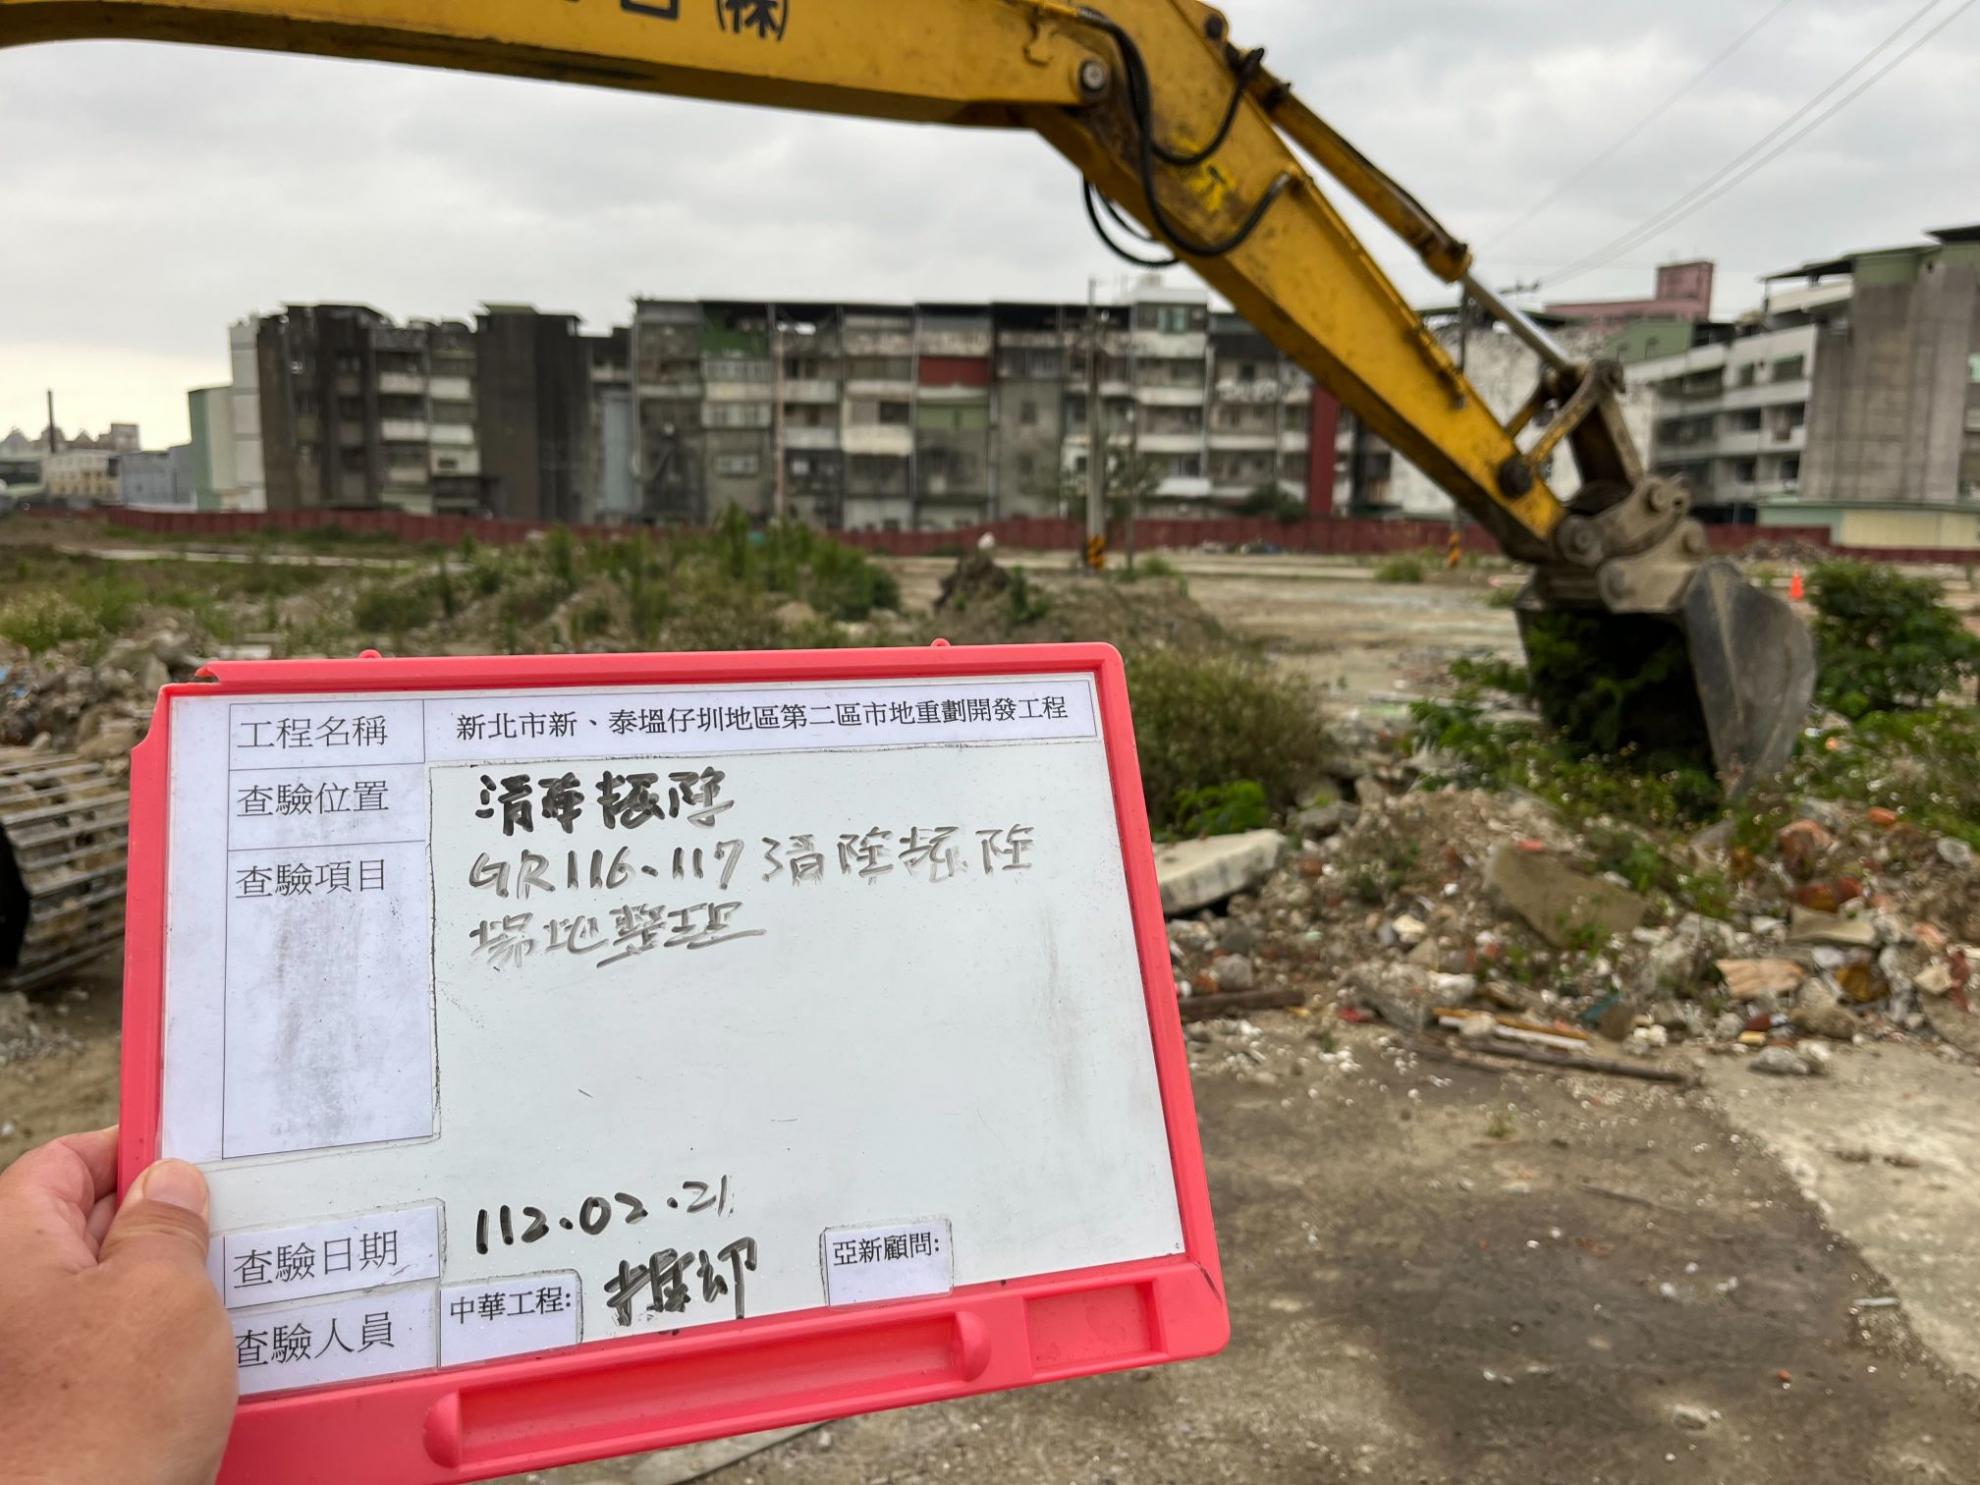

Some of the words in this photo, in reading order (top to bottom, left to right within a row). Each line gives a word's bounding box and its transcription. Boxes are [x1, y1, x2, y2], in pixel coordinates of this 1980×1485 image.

[236, 714, 389, 751] 工程名稱
[236, 780, 389, 818] 查驗位置
[235, 858, 386, 899] 查驗項目
[233, 1230, 398, 1289] 查驗日期
[236, 1311, 396, 1368] 查驗人員
